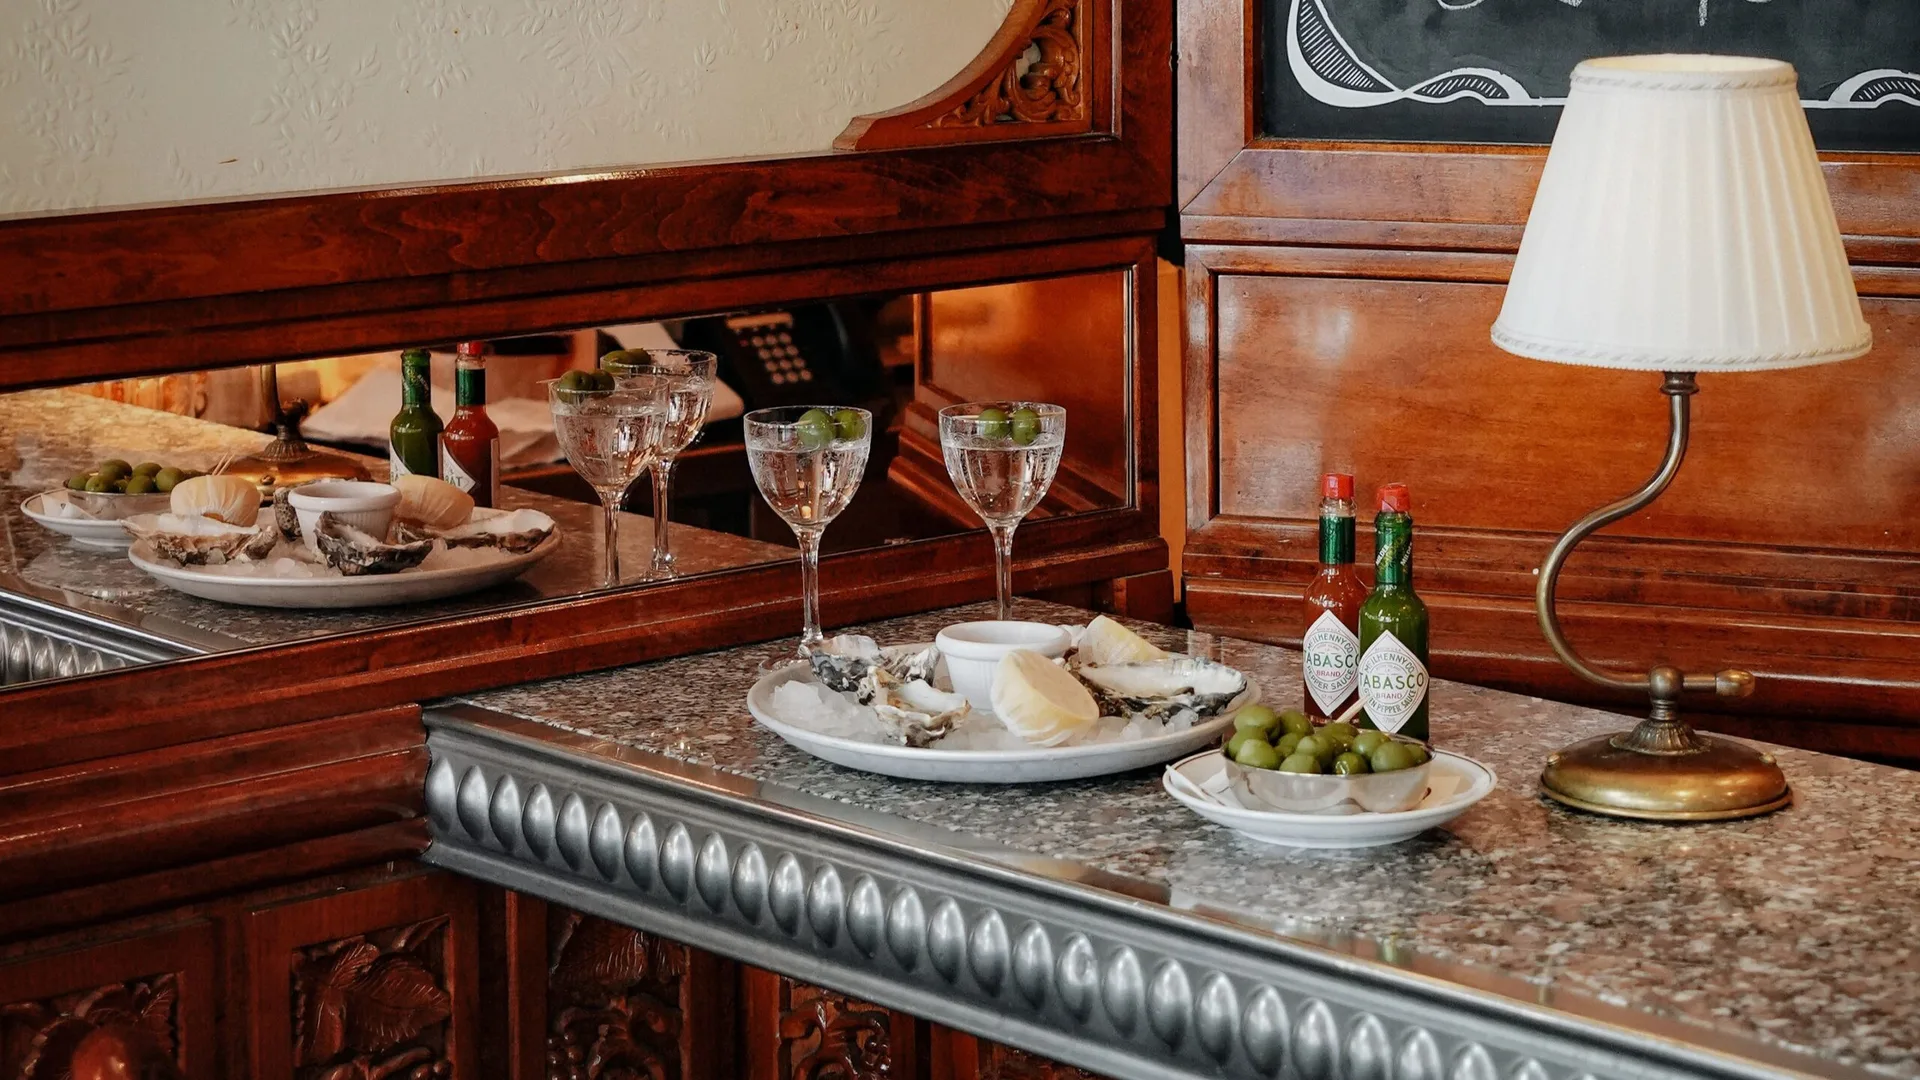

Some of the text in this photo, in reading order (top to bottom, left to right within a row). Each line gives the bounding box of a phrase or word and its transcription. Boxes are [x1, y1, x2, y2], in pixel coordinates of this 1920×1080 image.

[1305, 650, 1360, 669] ABASC
[1306, 665, 1354, 690] PEPPER SAUCE
[1359, 671, 1424, 690] TABASCO
[1364, 688, 1417, 714] GEN PEPPER SAUCE
[1375, 692, 1403, 700] BRAND
